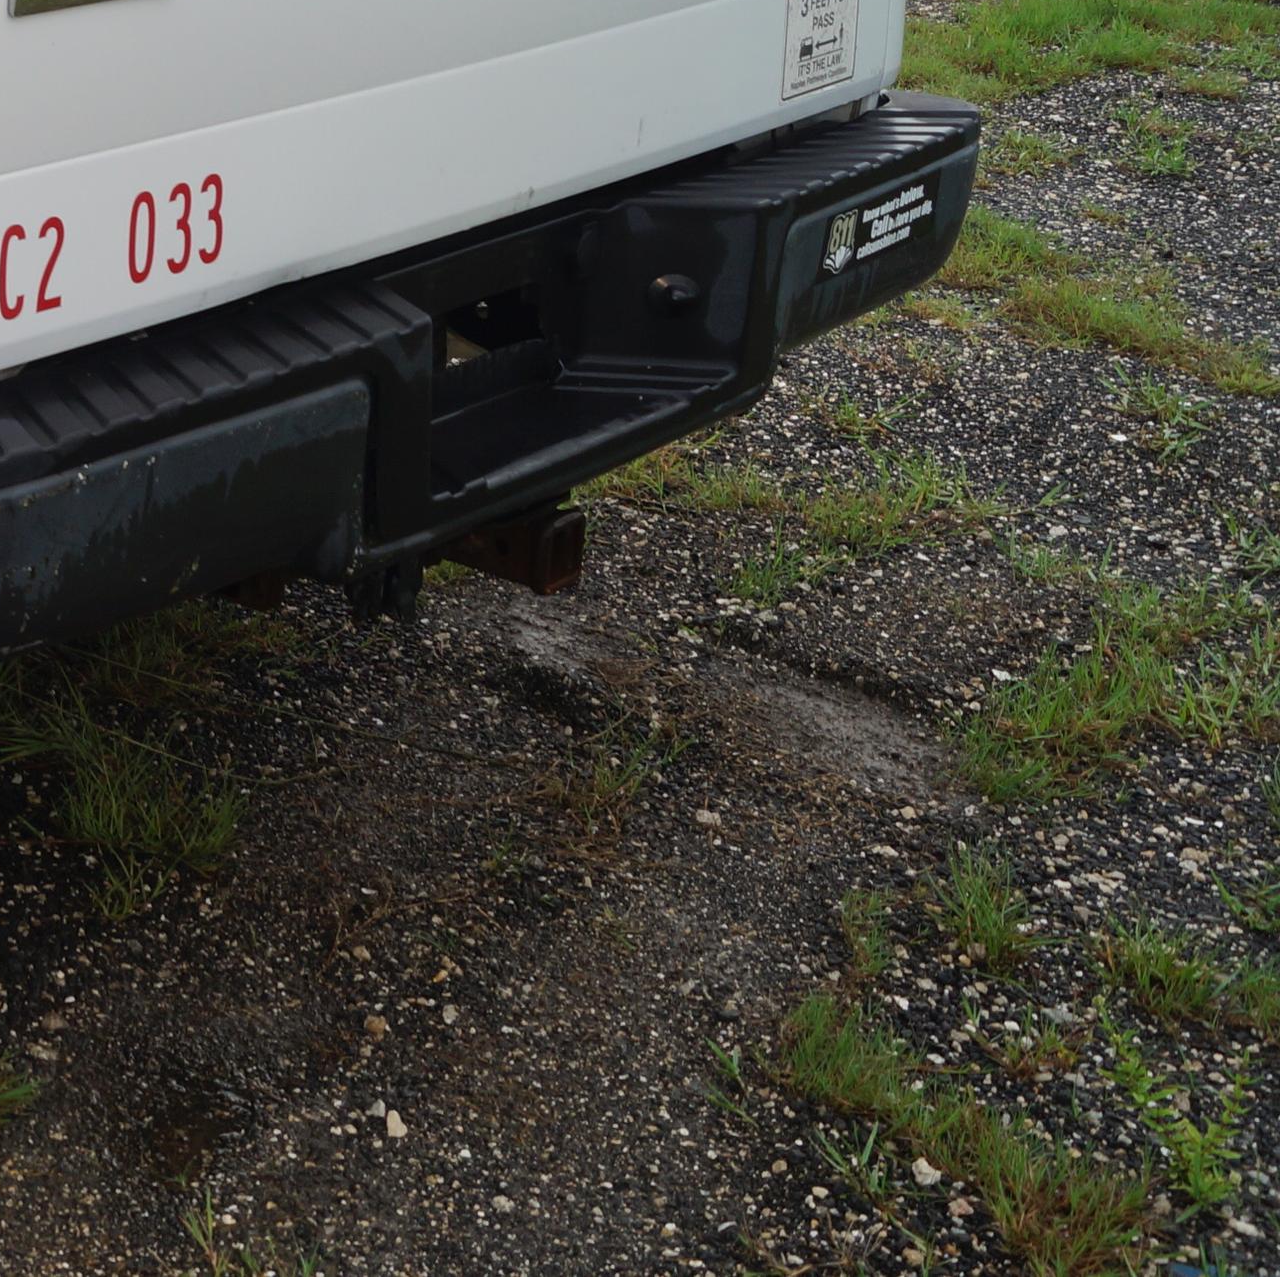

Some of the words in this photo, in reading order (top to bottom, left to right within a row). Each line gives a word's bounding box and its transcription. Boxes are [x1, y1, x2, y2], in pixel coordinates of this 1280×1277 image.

[812, 12, 835, 31] PASS
[797, 62, 811, 78] IT'S
[812, 57, 825, 74] THE
[826, 52, 842, 68] LAW
[871, 214, 890, 239] Call
[909, 205, 922, 223] you
[880, 198, 900, 216] what's
[127, 172, 224, 285] 033
[829, 212, 857, 254] 811
